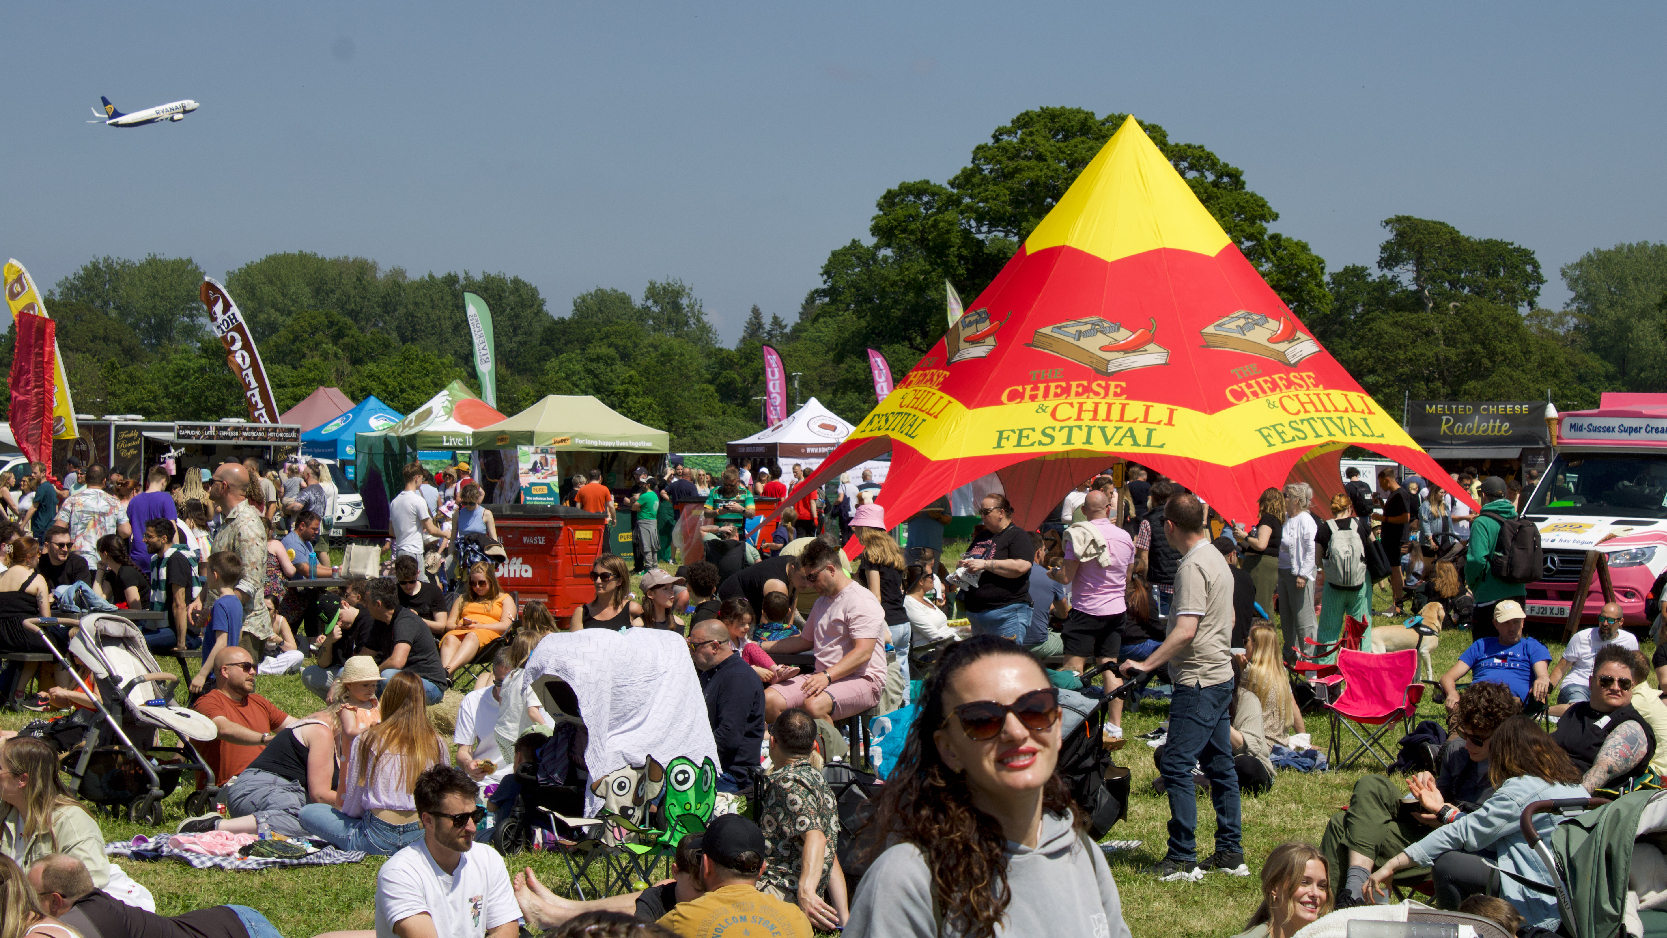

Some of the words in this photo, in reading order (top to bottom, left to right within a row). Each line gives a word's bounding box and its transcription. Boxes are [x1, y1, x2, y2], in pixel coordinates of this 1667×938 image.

[155, 102, 187, 115] RYANAIR
[1029, 368, 1065, 381] THE
[1230, 363, 1262, 380] THE
[1001, 380, 1128, 405] CHEESE
[1225, 371, 1325, 405] CHEESE
[899, 388, 954, 420] CHILLI
[1035, 403, 1050, 414] &
[1049, 401, 1178, 427] CHILLI
[1265, 398, 1279, 410] &
[1278, 392, 1376, 416] CHILLI
[1425, 404, 1473, 414] MELTED
[1480, 404, 1529, 414] CHEESE
[860, 411, 927, 440] FESTIVAL
[1254, 416, 1385, 448] FESTIVAL
[1440, 415, 1513, 436] Raclette
[1569, 422, 1616, 433] Mid-Sussex
[1617, 423, 1643, 437] Super
[1644, 423, 1667, 434] Crea
[442, 435, 464, 446] Live
[585, 438, 597, 447] long
[598, 439, 615, 447] happy
[992, 424, 1167, 450] FESTIVAL
[523, 536, 546, 544] WASTE
[1530, 606, 1548, 615] FJ21
[1549, 607, 1565, 616] XJB
[750, 915, 782, 938] STONE
